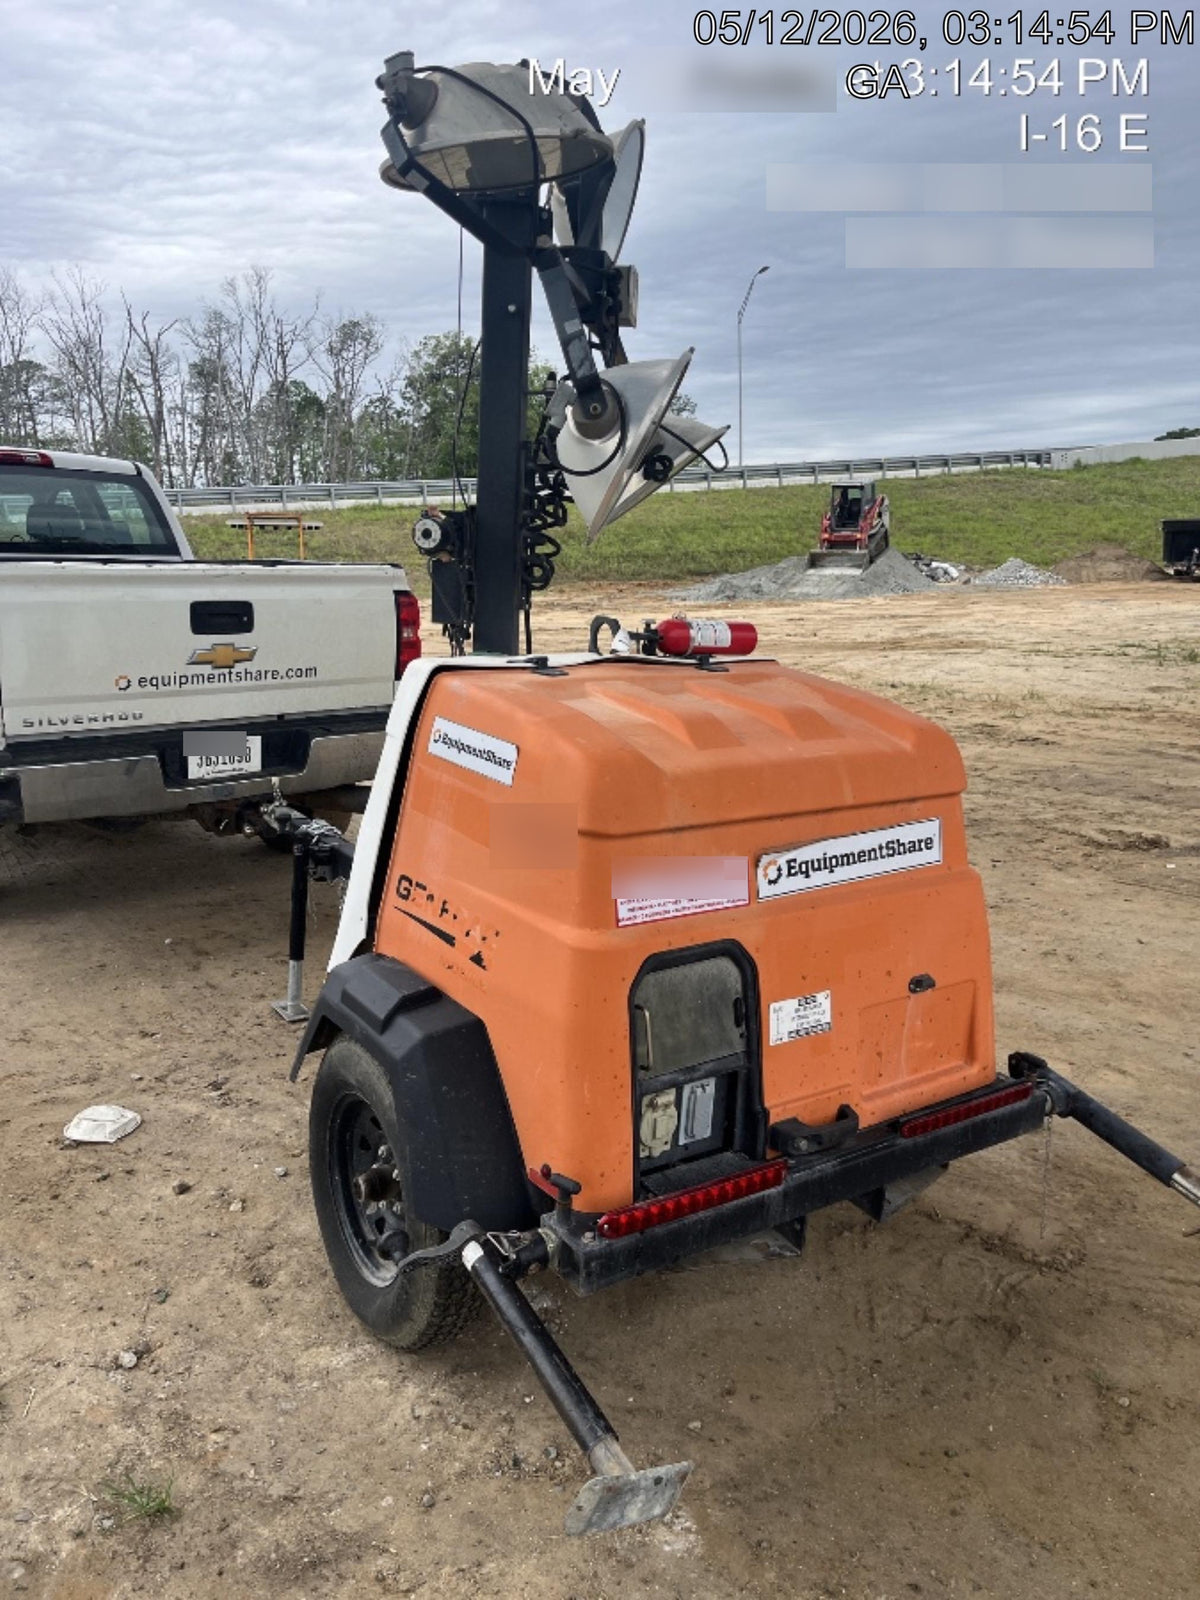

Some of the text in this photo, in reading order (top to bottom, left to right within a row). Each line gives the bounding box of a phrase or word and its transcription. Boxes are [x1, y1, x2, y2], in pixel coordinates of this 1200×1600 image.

[137, 666, 318, 690] equipmentshare.com
[441, 732, 513, 771] EquipmentShare
[786, 835, 935, 879] EquipmentShare
